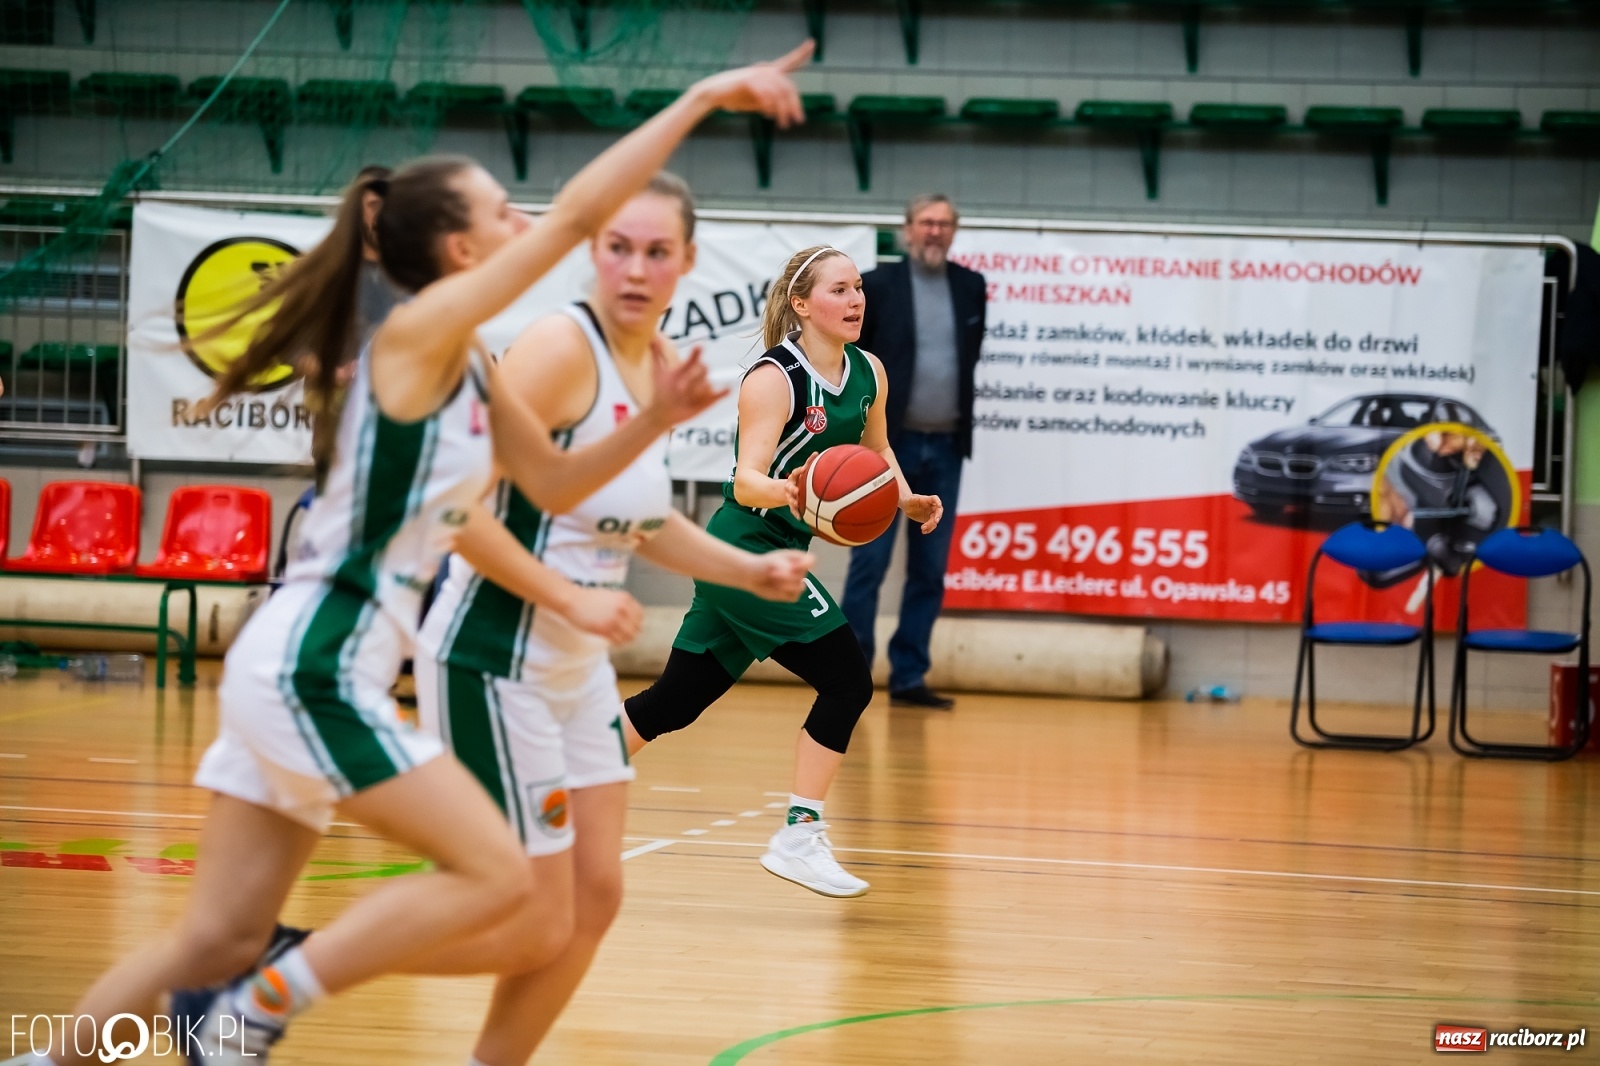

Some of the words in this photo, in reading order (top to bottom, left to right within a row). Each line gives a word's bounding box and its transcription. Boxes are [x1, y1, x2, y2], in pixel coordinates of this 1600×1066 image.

[1071, 256, 1220, 279] OTWIERANIE
[1230, 259, 1421, 286] SAMOCHODÓW
[1006, 282, 1132, 305] MIESZKAŃ
[1036, 322, 1129, 344] zamków,
[1137, 325, 1218, 348] kłódek,
[1224, 330, 1316, 351] wkładek
[1324, 331, 1351, 350] do
[1359, 333, 1418, 354] drzwi
[171, 397, 311, 430] RACIBÓR
[1053, 389, 1097, 403] oraz
[1104, 385, 1219, 408] kodowanie
[1226, 389, 1296, 414] kluczy
[1027, 416, 1205, 441] samochodowych
[960, 521, 1038, 560] 695
[1046, 524, 1123, 565] 496
[1130, 528, 1208, 568] 555
[943, 566, 1018, 592] acibórz
[1120, 575, 1148, 599] ul.
[1152, 575, 1256, 604] Opawska
[1259, 581, 1291, 604] 45
